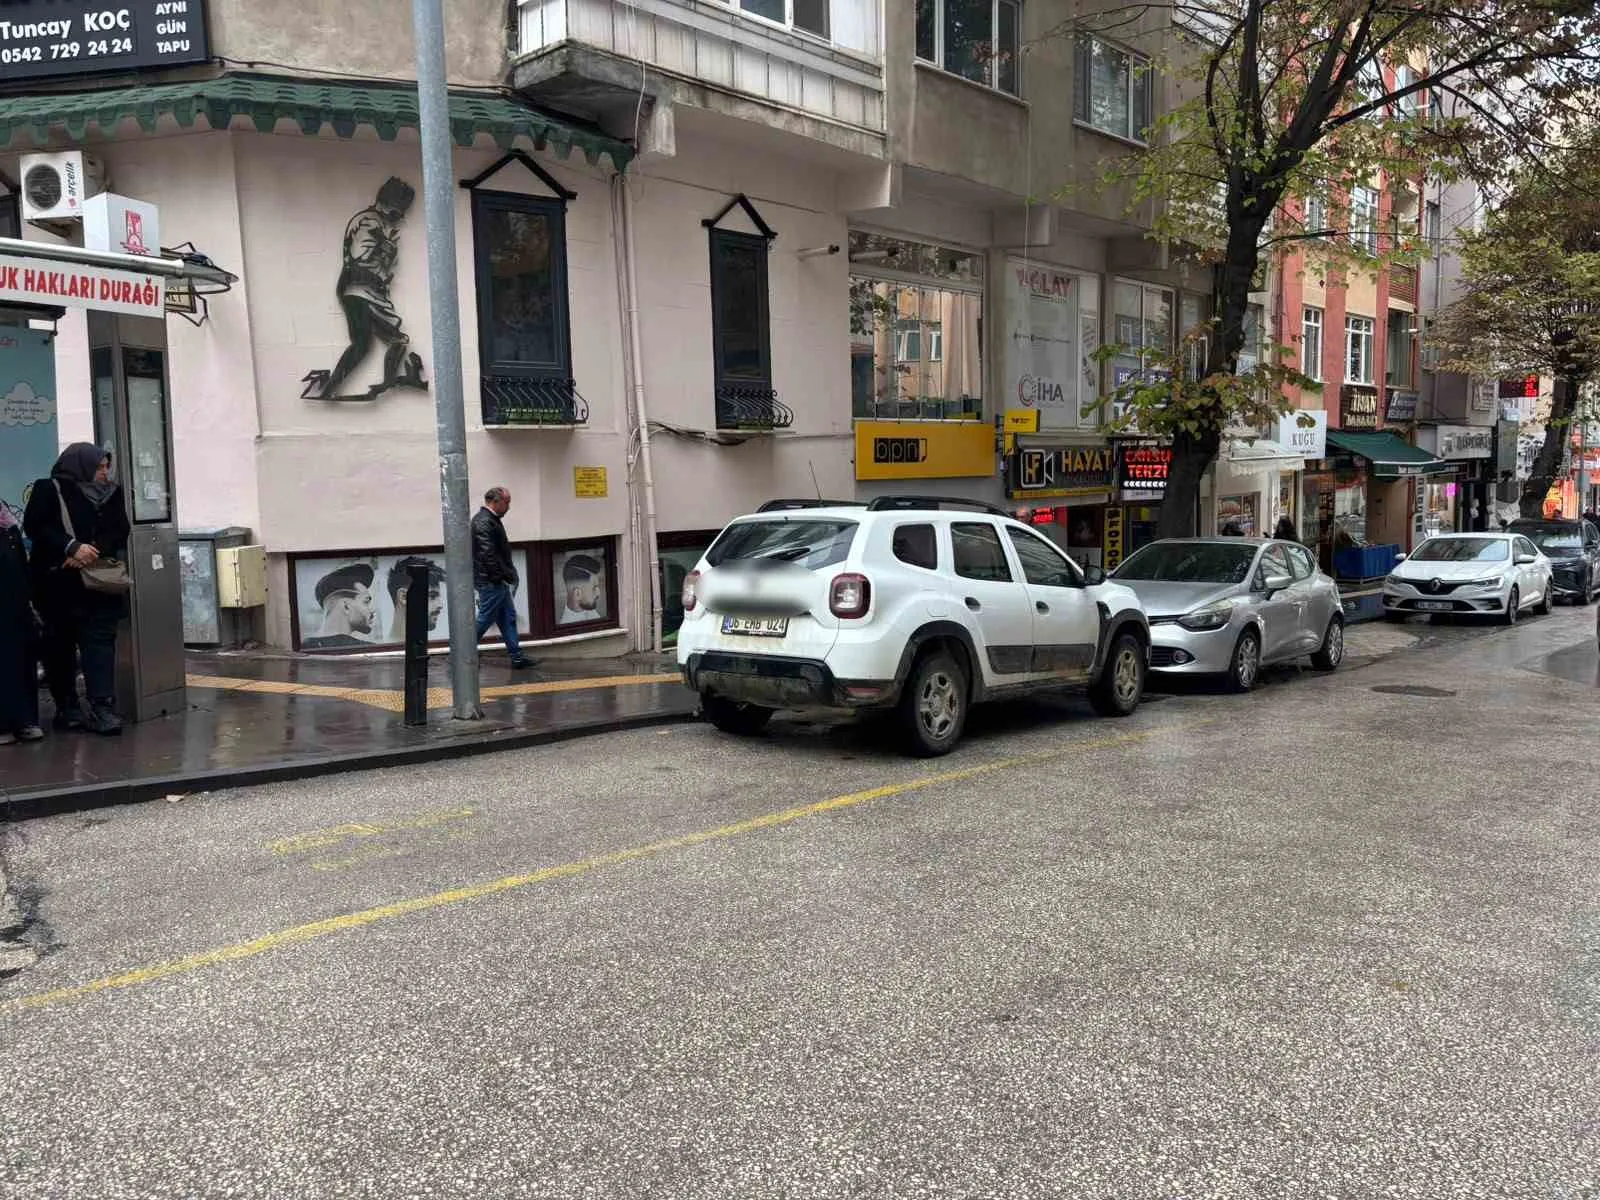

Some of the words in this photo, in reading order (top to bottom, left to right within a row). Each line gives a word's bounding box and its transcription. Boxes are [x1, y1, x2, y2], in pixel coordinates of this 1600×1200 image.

[155, 1, 187, 15] AYNI
[0, 19, 72, 40] Tuncay
[83, 9, 130, 32] KOÇ
[156, 19, 187, 35] GÜN
[1, 47, 42, 63] 0542
[50, 42, 80, 59] 729
[156, 40, 190, 54] TAPU
[24, 268, 96, 299] HAKLARI
[100, 275, 159, 307] DURAĞI
[1061, 448, 1113, 473] HAYAT
[1127, 463, 1169, 478] TERZİ
